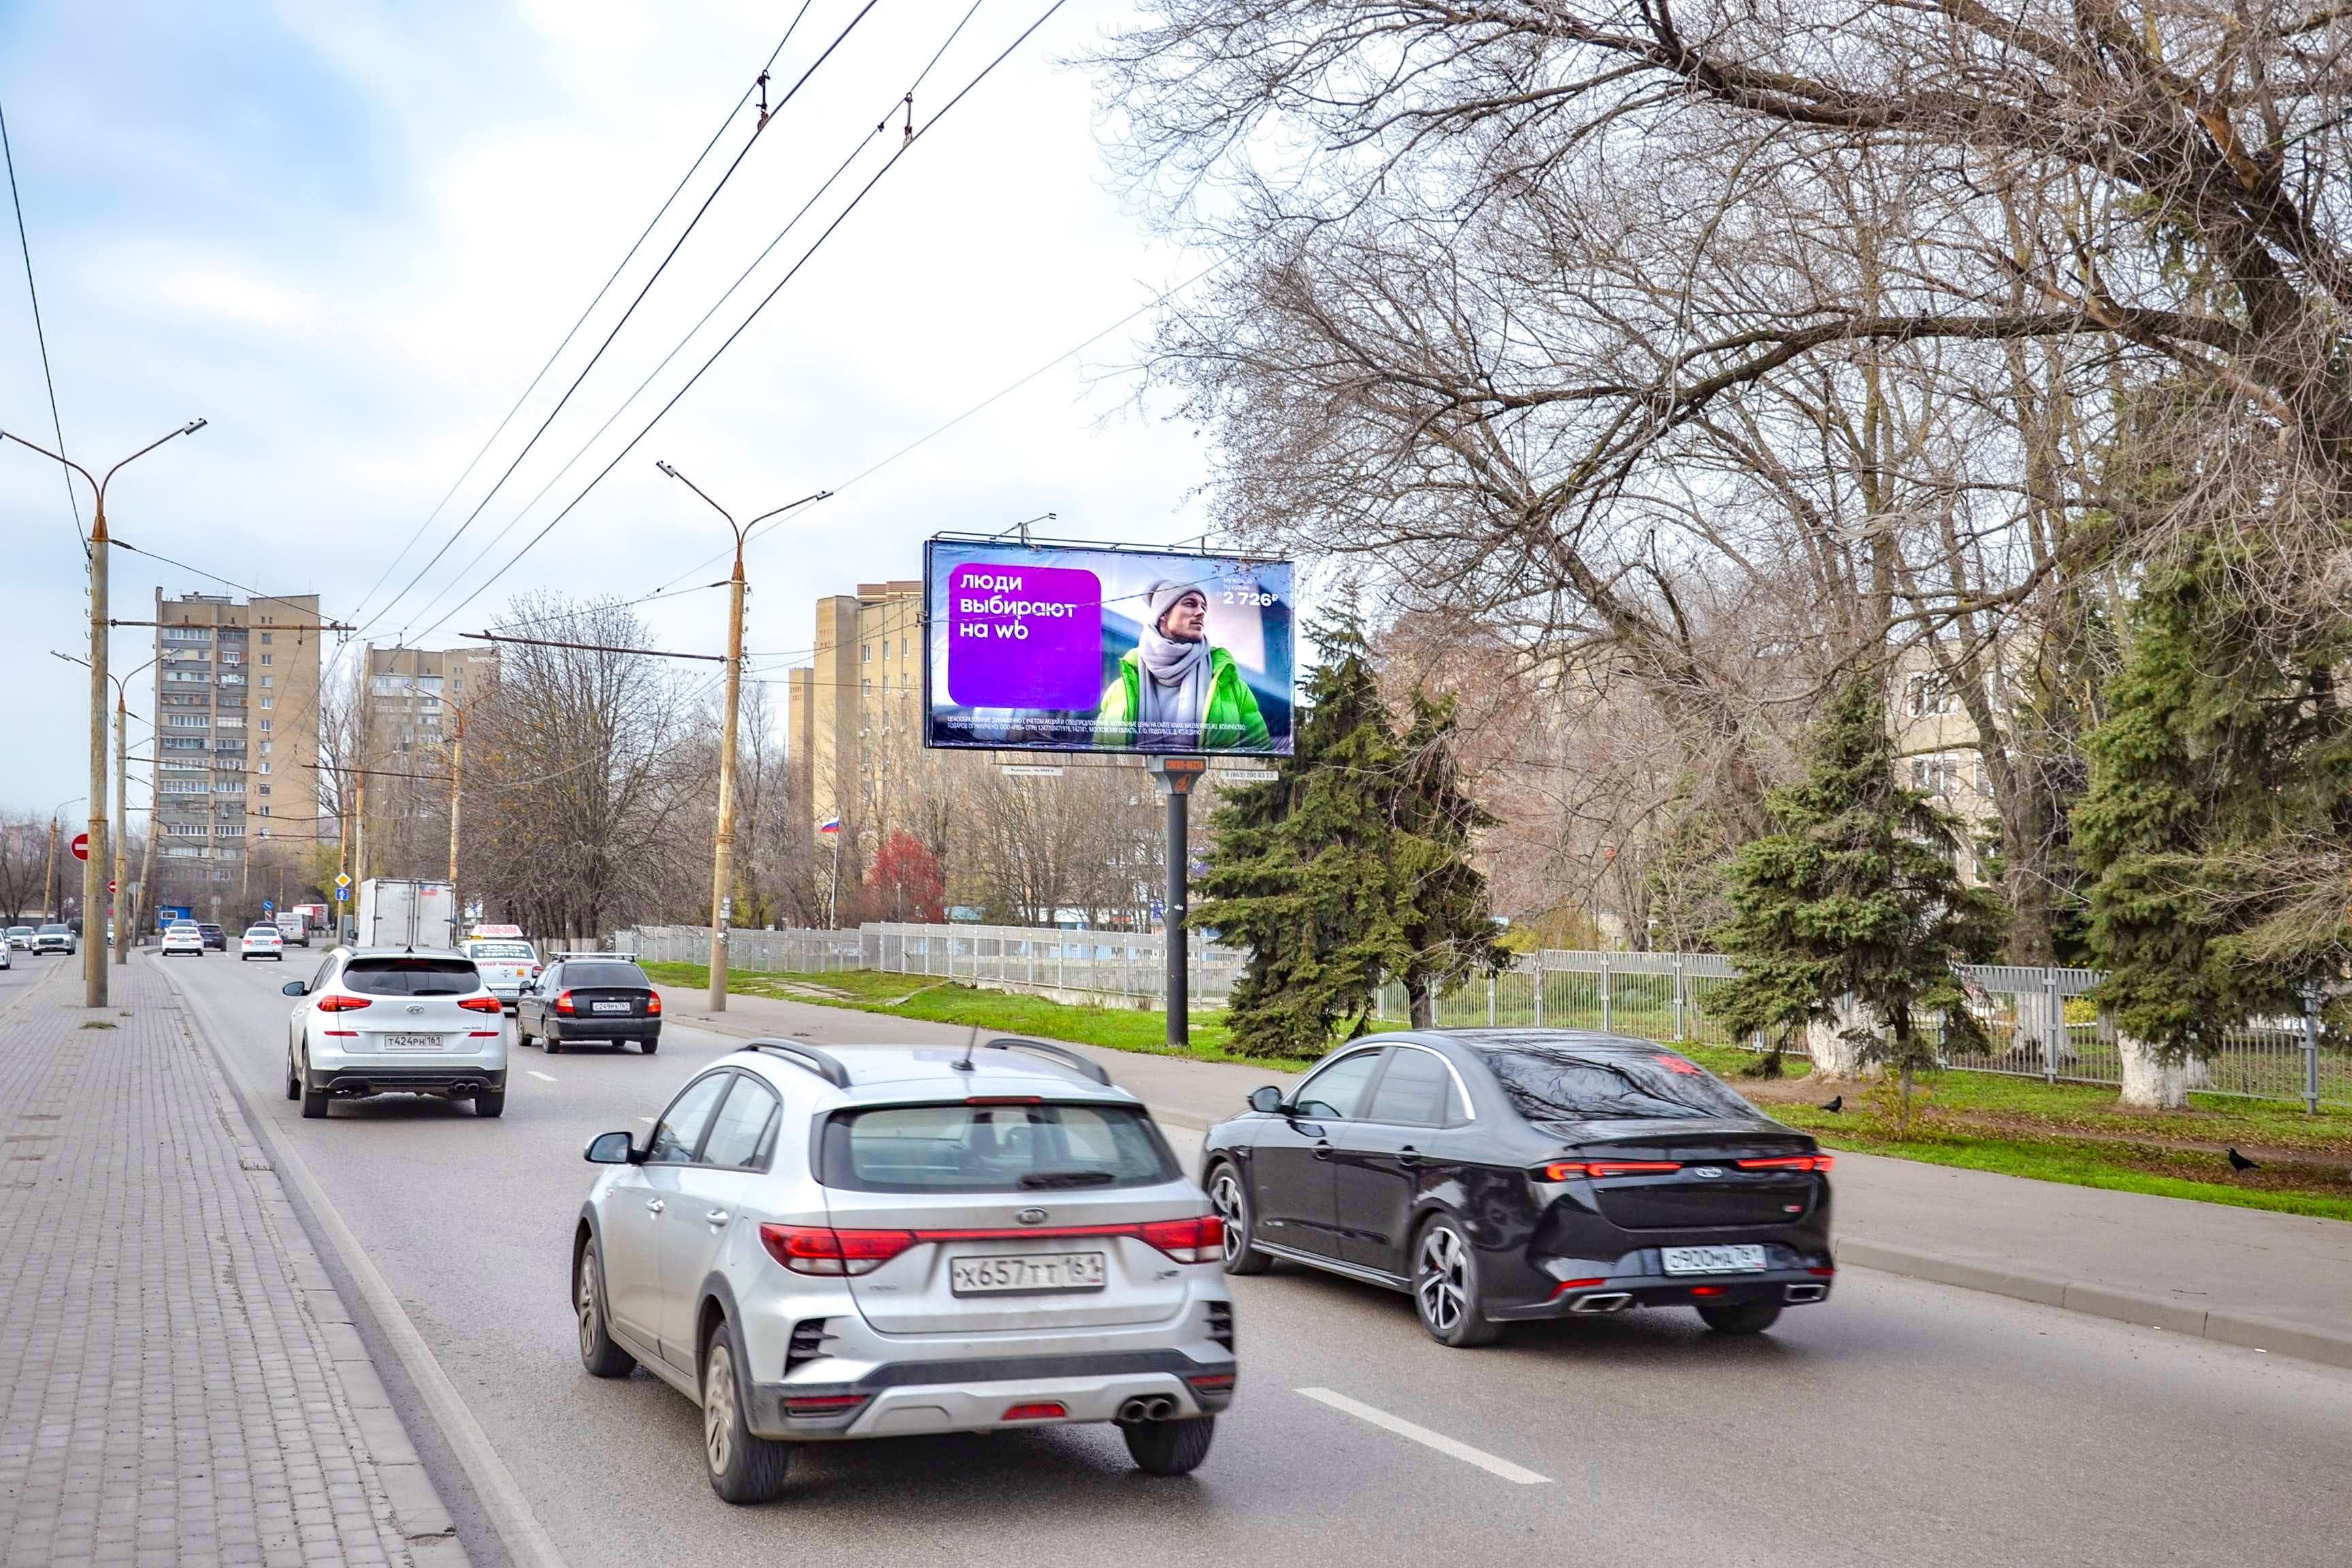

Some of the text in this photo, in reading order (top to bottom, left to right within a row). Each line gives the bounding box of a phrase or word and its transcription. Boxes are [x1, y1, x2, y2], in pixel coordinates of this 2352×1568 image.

[960, 574, 1022, 593] люди
[960, 594, 1077, 620] выбирают
[960, 619, 1029, 640] на wb
